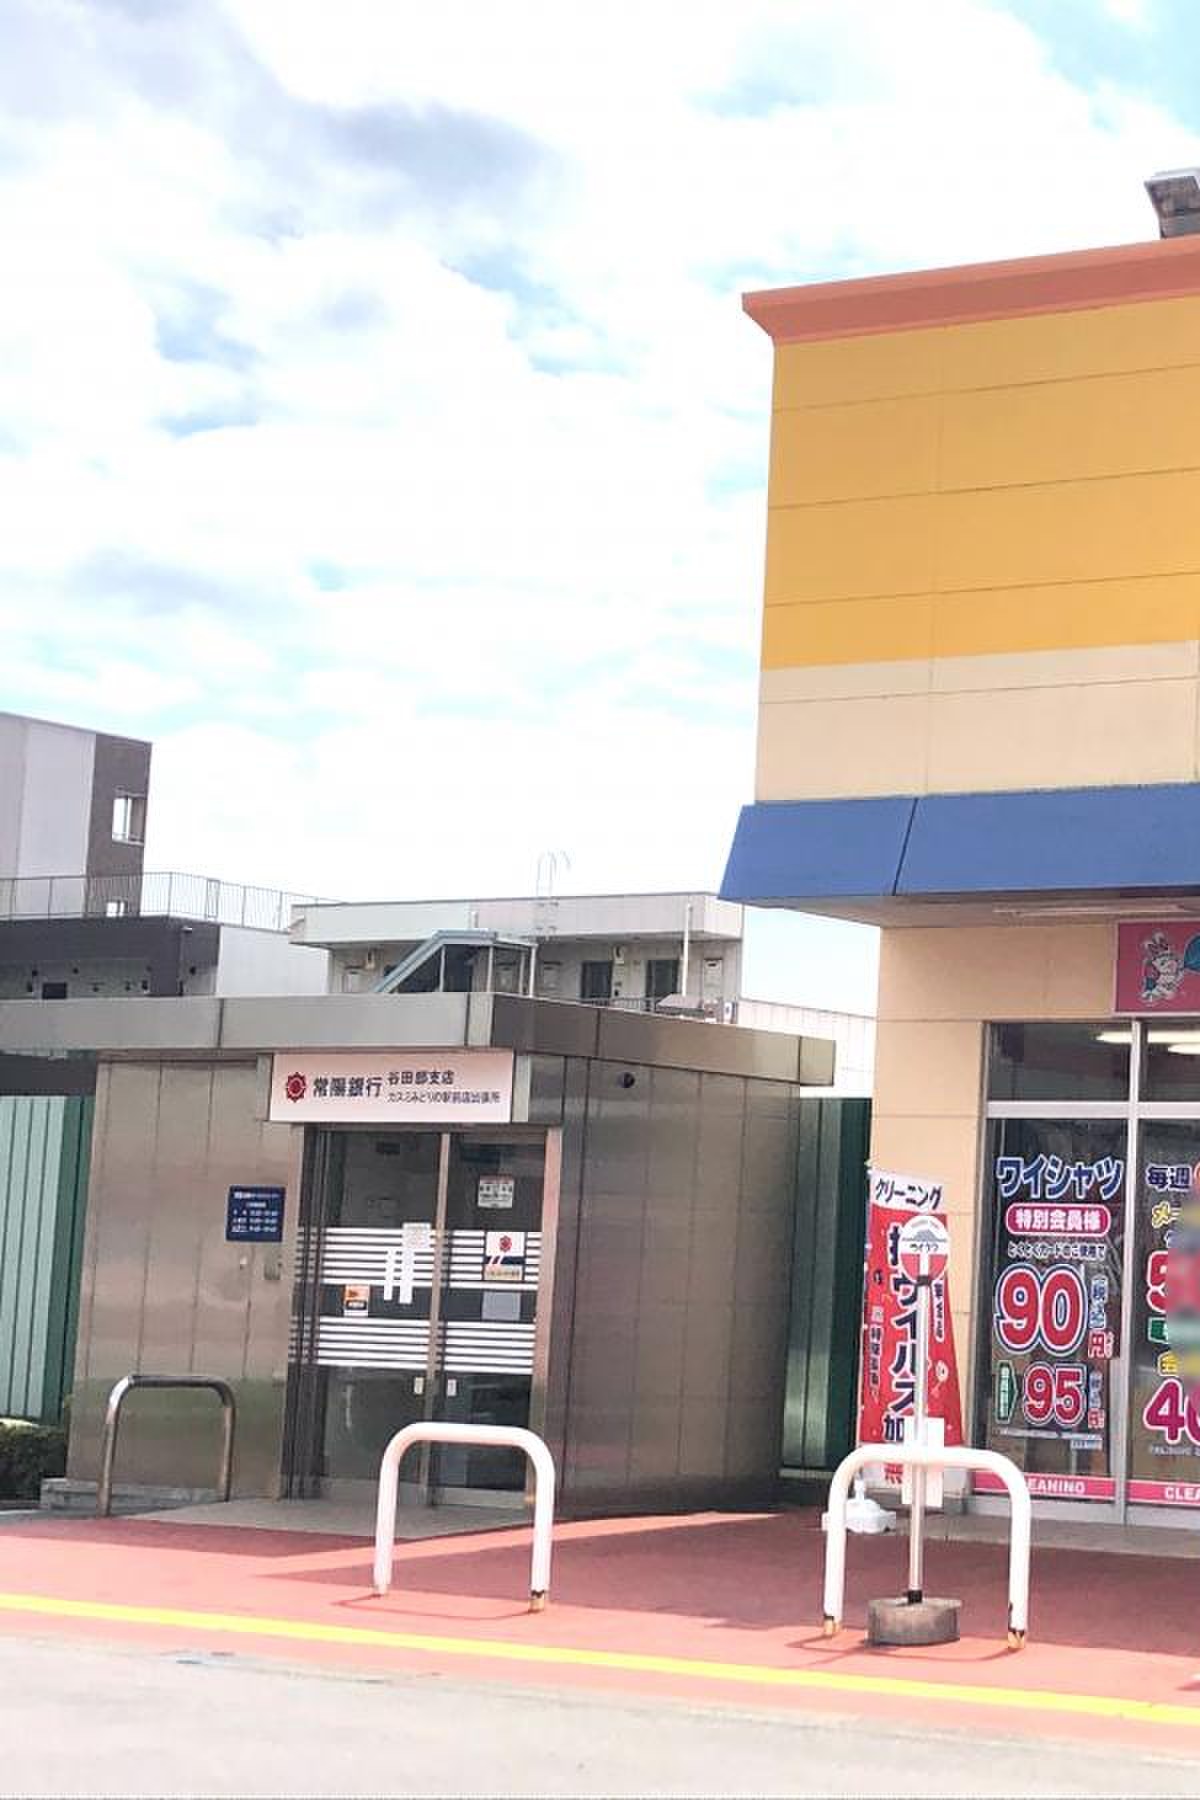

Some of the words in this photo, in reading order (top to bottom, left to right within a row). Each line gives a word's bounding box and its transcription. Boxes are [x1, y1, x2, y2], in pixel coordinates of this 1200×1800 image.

[313, 1076, 383, 1098] 常陽銀行
[387, 1070, 455, 1086] 谷田部支店
[996, 1154, 1124, 1200] ワイシャツ
[875, 1179, 943, 1210] クリーニング
[1015, 1208, 1101, 1231] 特別会員様
[995, 1263, 1088, 1356] 90
[1023, 1361, 1087, 1426] 95
